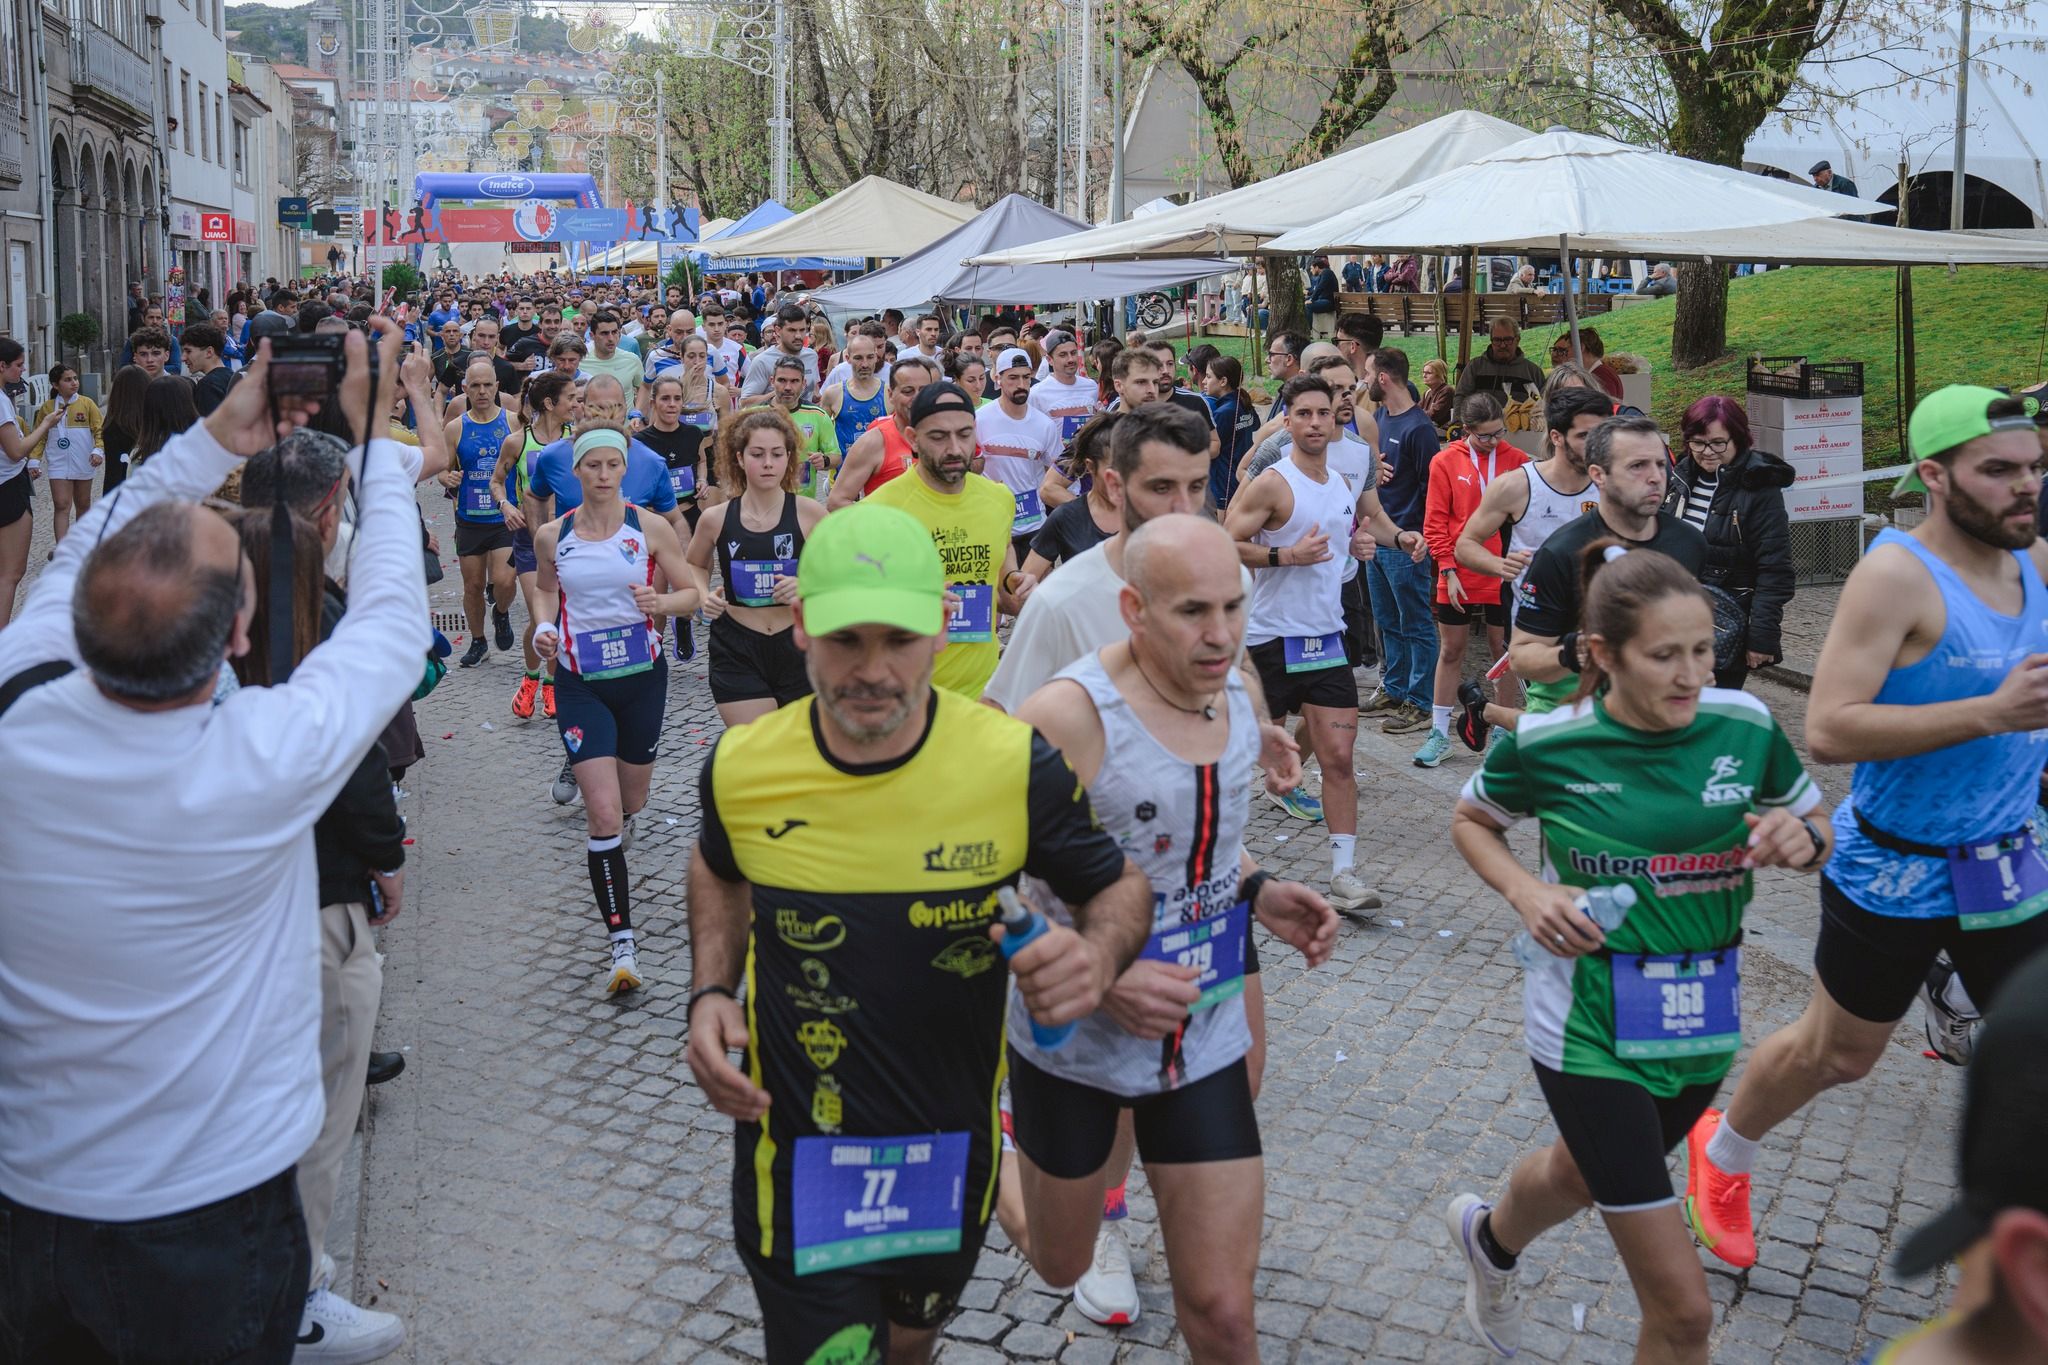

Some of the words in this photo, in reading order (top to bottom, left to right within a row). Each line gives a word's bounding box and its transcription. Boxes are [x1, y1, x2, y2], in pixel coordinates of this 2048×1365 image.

[939, 544, 991, 563] SILVESTRE
[945, 562, 972, 575] BRAGA
[754, 573, 775, 588] 301
[601, 639, 627, 659] 253
[1304, 637, 1323, 652] 104
[1702, 786, 1754, 803] NAT
[1661, 981, 1705, 1017] 368
[861, 1168, 897, 1208] 77
